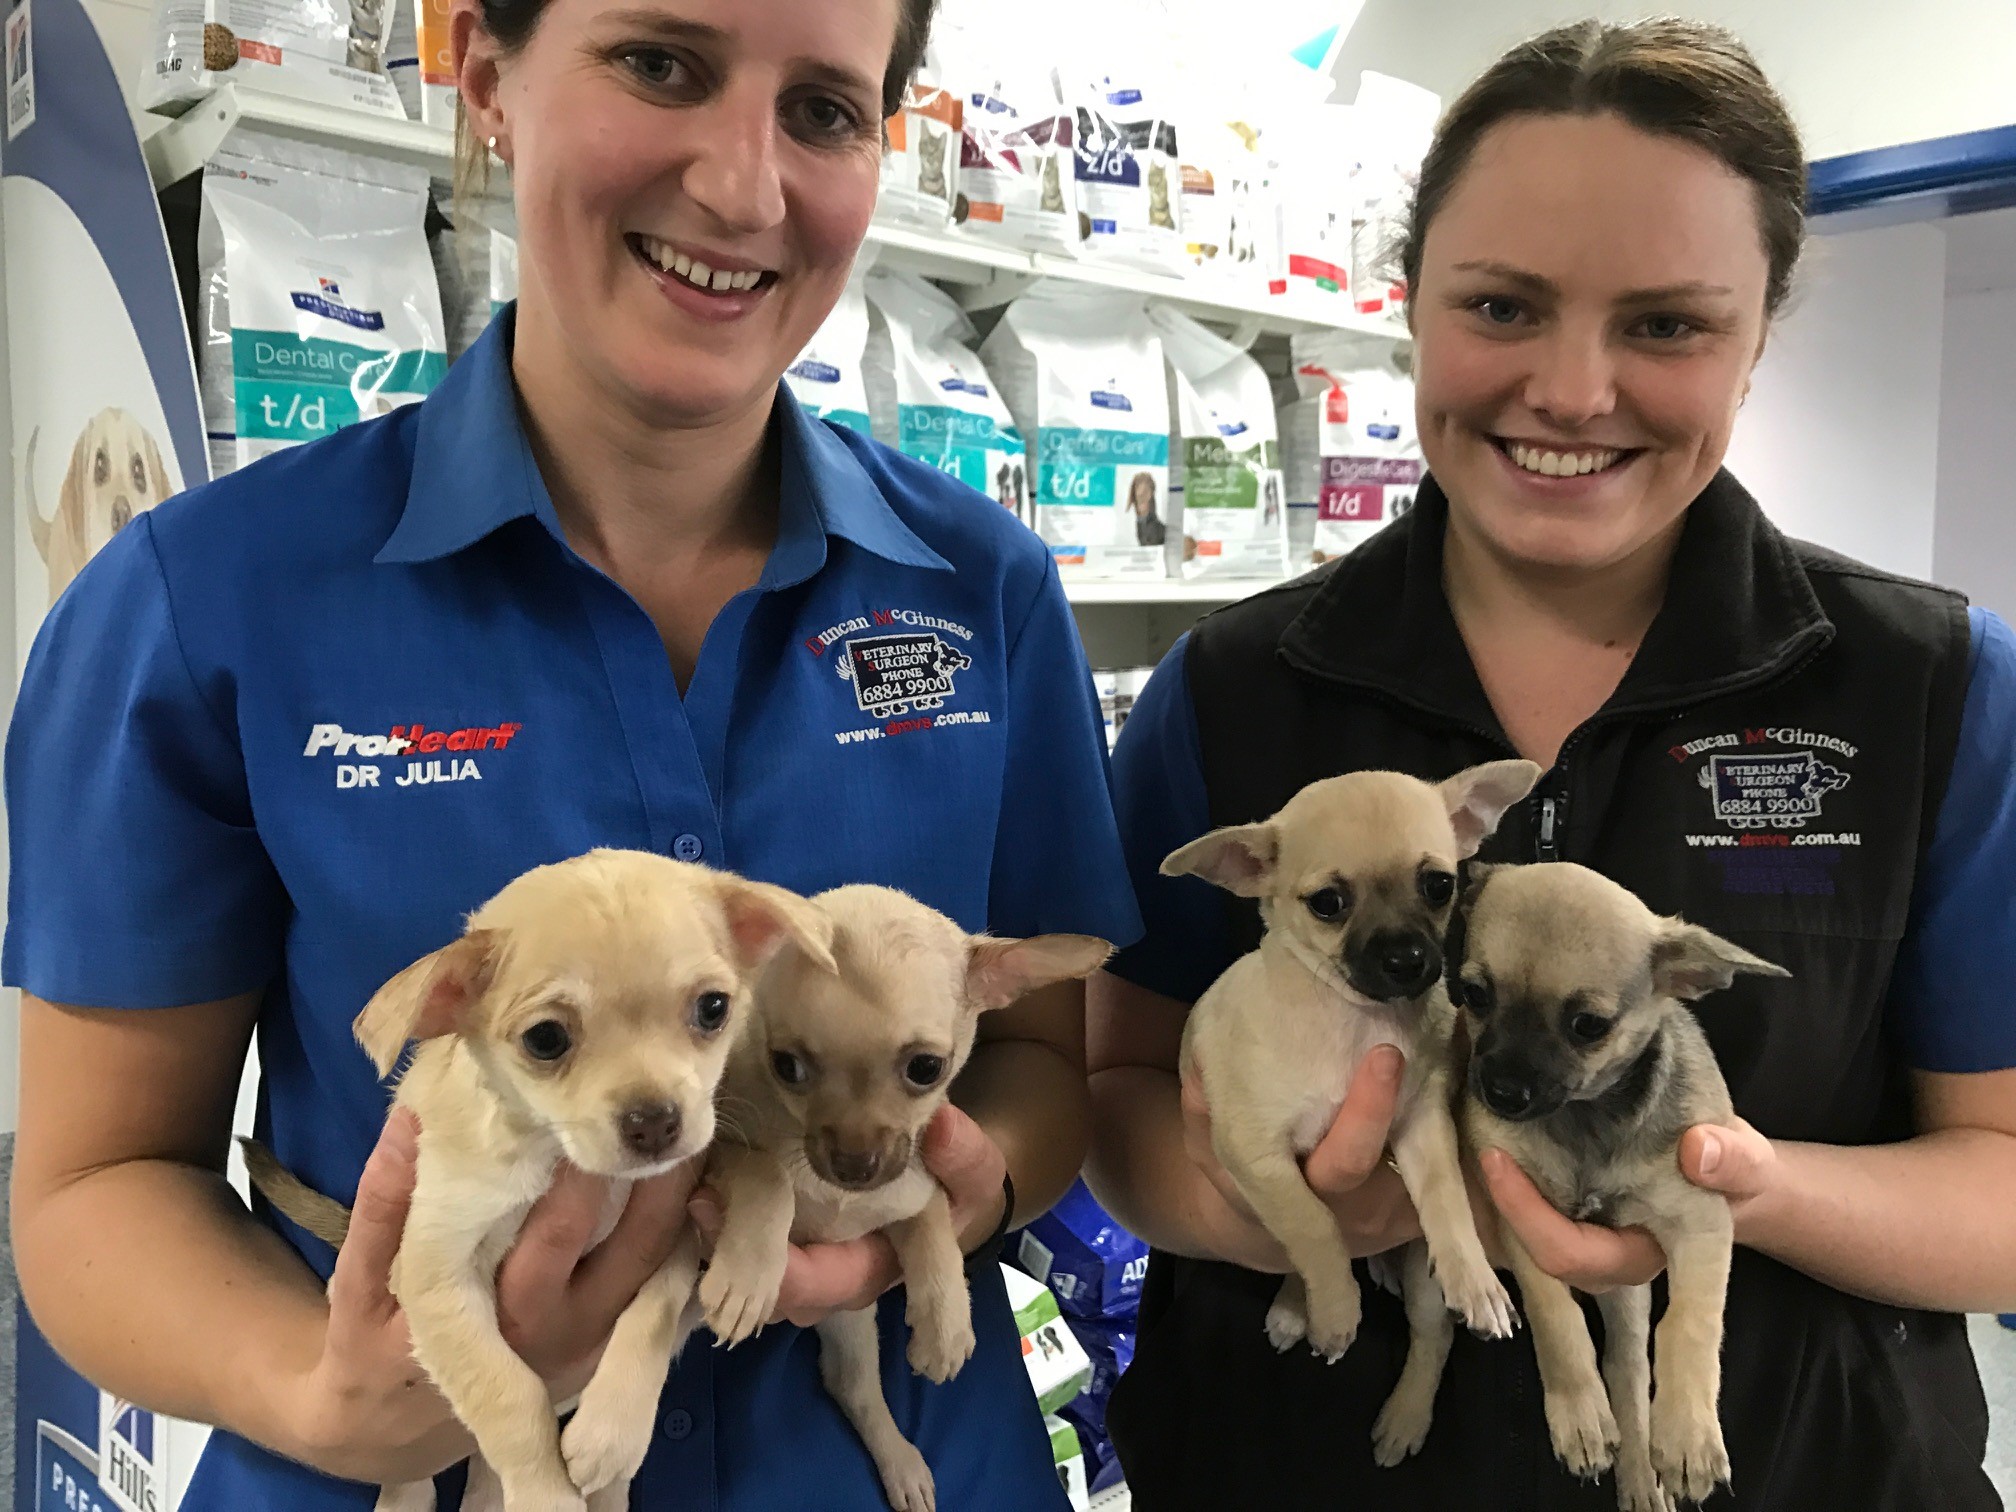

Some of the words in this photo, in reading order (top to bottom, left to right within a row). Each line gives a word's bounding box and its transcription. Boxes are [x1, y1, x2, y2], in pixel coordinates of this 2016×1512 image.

[1086, 148, 1123, 176] z/d
[255, 342, 335, 370] Dental
[260, 393, 326, 430] t/d
[1051, 470, 1090, 499] t/d
[1328, 491, 1361, 516] i/d
[805, 616, 871, 657] Duncan
[872, 609, 974, 641] McGinness
[854, 642, 933, 662] VETERINARY
[868, 653, 928, 671] SURGEON
[881, 667, 924, 682] PHONE
[863, 684, 903, 703] 6884
[906, 676, 948, 695] 9900
[835, 711, 991, 744] www.dmvs.com.au
[1668, 732, 1739, 763] Duncan
[1744, 727, 1859, 758] McGinness
[336, 764, 381, 788] DR
[395, 758, 482, 786] JULIA
[1720, 798, 1762, 814] 6884
[1766, 797, 1814, 812] 9900
[1741, 787, 1788, 799] PHONE
[1121, 1254, 1149, 1284] AD
[52, 1461, 101, 1512] PRE
